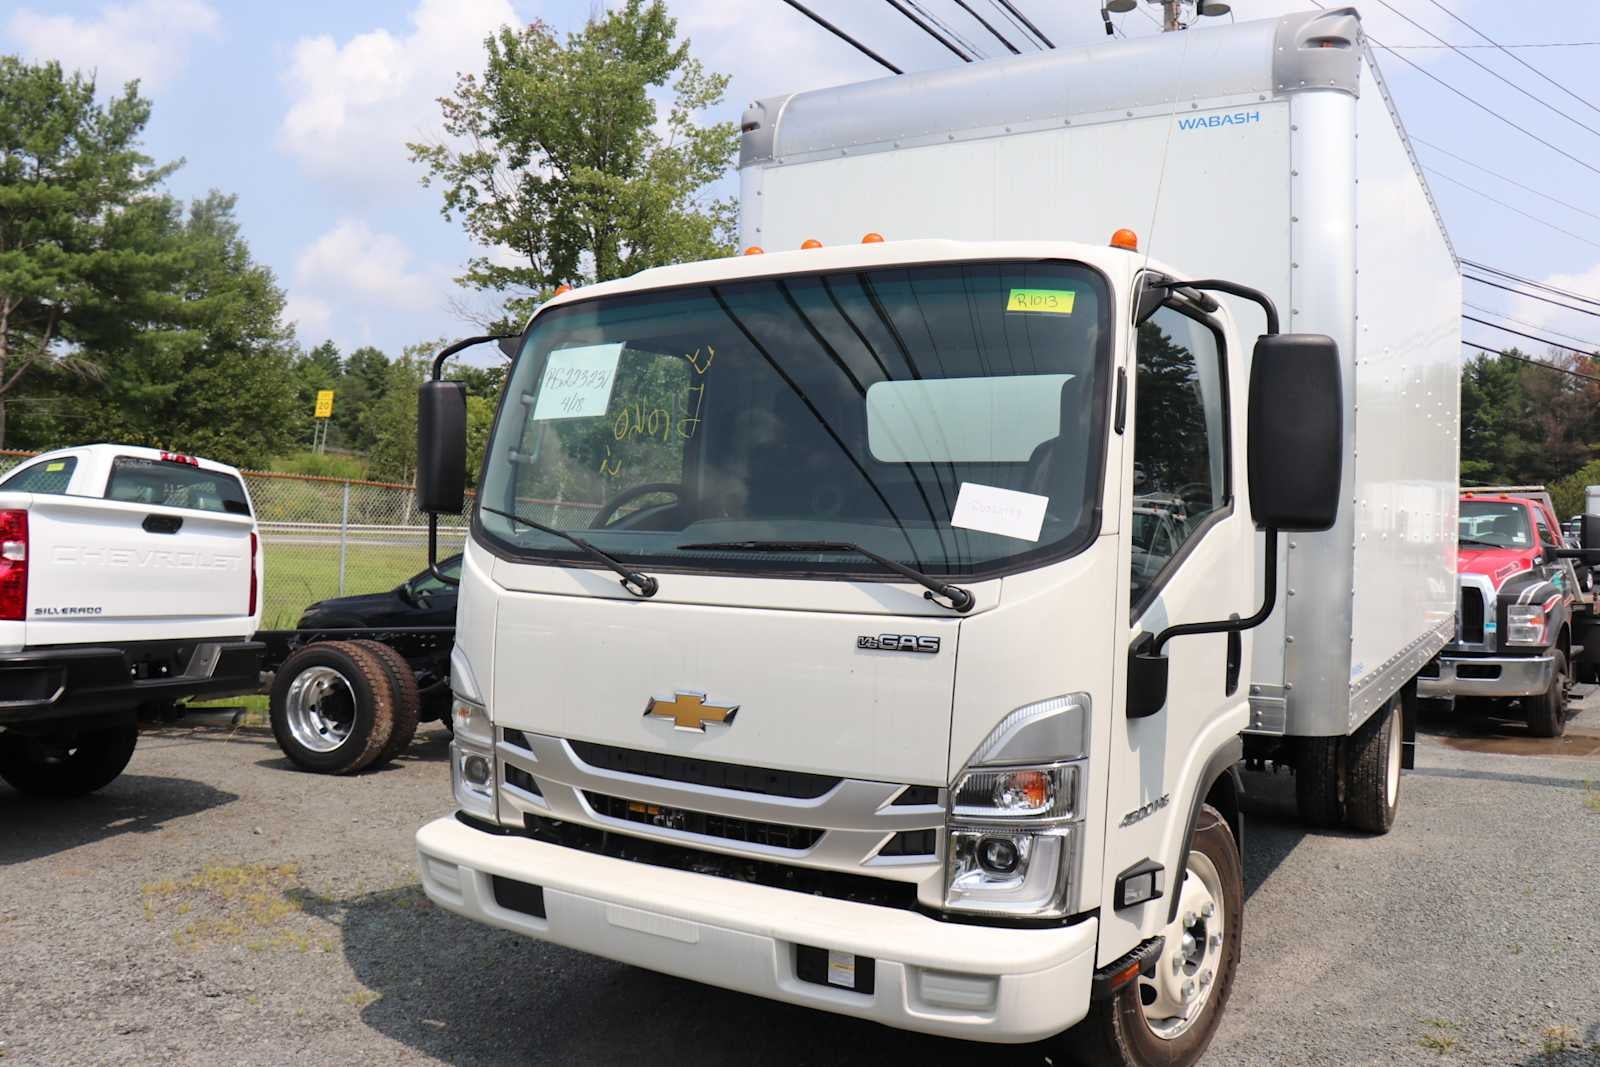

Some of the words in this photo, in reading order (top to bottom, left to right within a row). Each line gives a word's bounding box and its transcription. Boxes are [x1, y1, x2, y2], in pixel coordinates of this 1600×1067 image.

[1178, 111, 1260, 131] WABASH
[49, 544, 242, 572] CHEVROLET
[34, 606, 102, 616] SILVERADO
